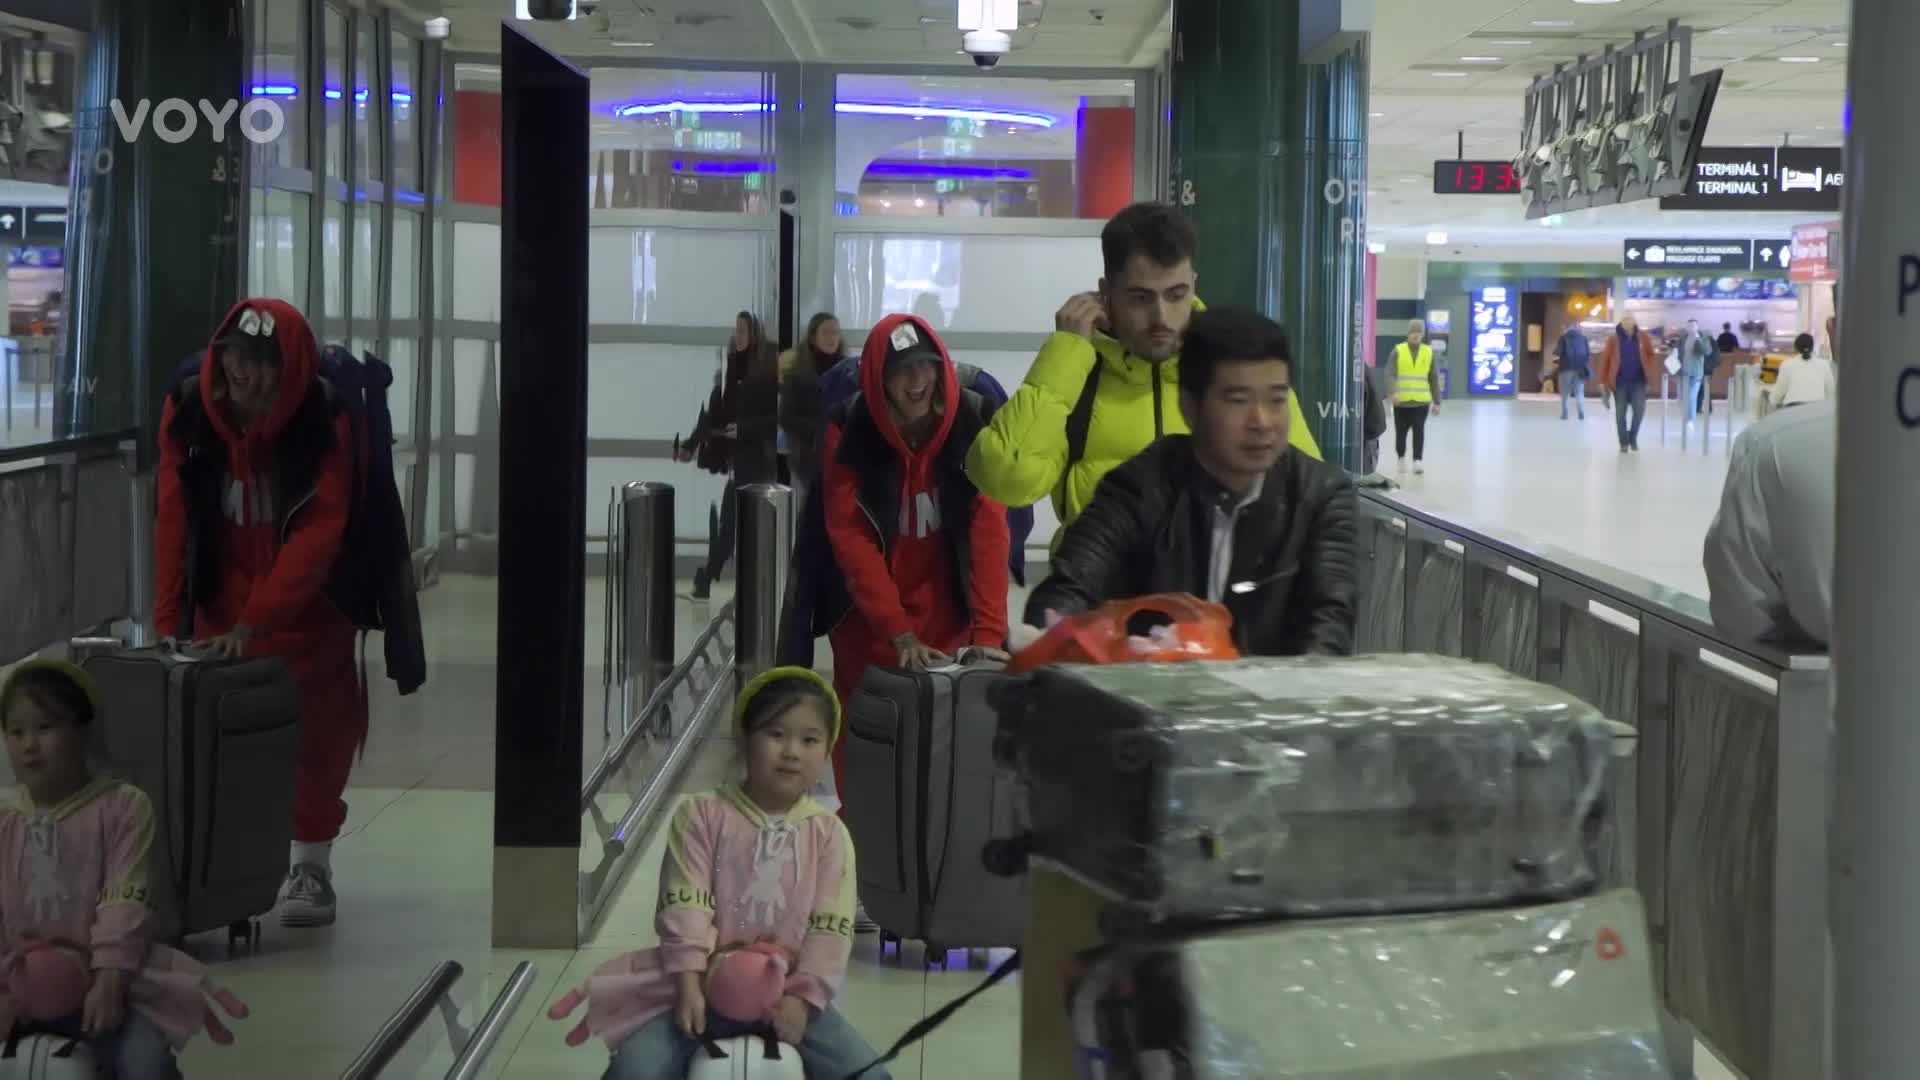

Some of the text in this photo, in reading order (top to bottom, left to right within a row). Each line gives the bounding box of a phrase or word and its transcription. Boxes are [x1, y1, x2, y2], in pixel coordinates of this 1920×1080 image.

[1697, 161, 1769, 176] TERMINÁL 1
[1697, 181, 1769, 194] TERMINAL 1
